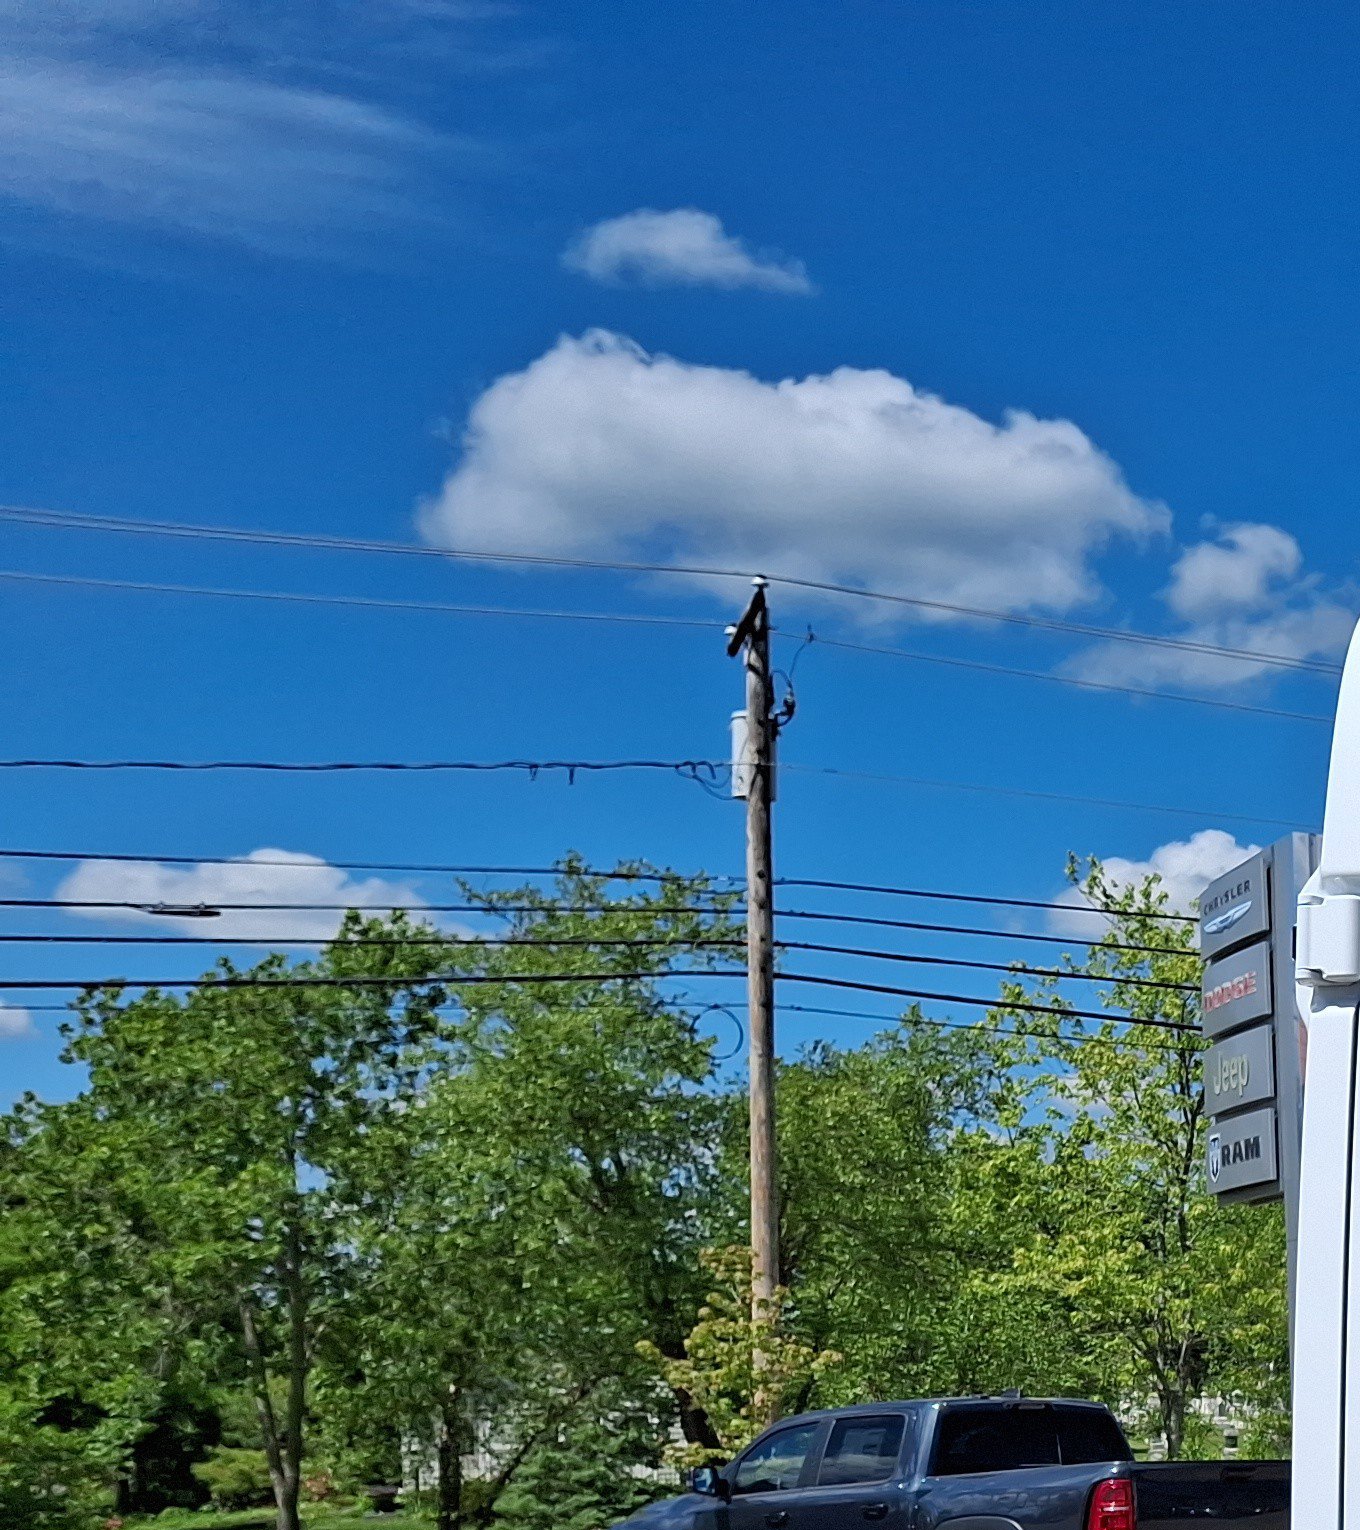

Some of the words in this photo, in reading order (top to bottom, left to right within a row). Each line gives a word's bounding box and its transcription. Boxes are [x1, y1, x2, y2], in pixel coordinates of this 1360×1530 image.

[1203, 879, 1251, 916] CHRYSLER
[1203, 970, 1257, 1013] DODGE
[1213, 1051, 1250, 1097] Jeep
[1221, 1135, 1261, 1168] RAM
